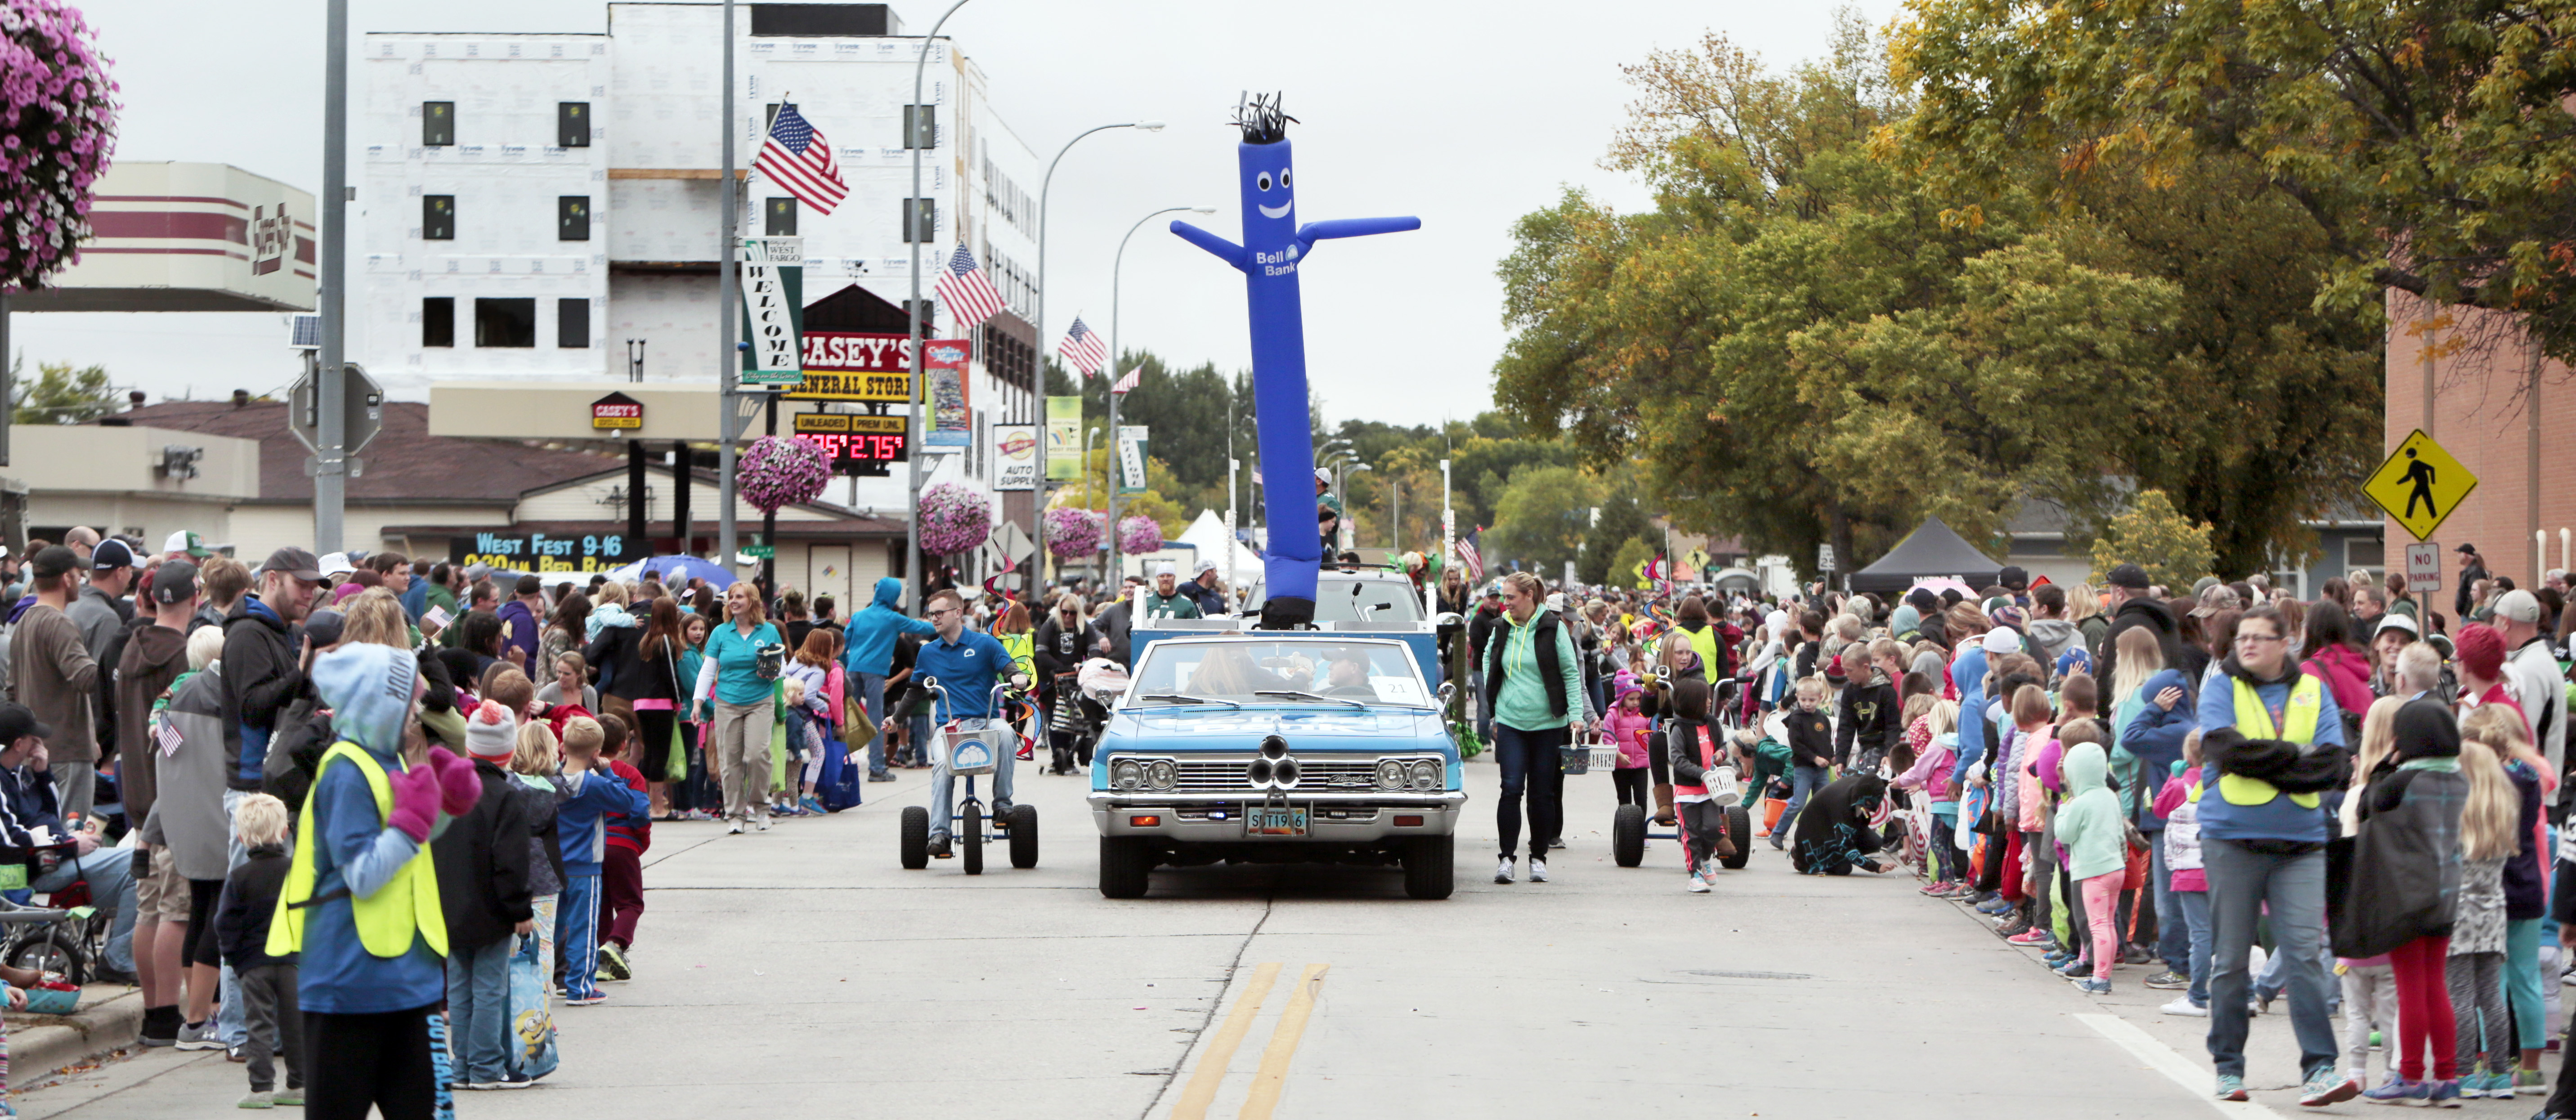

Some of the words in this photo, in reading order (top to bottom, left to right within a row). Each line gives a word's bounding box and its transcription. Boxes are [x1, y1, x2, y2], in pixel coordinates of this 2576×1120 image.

[1256, 251, 1284, 264] Bell
[1265, 262, 1295, 276] Bank
[748, 266, 789, 366] WELCOME
[746, 372, 760, 380] City
[801, 418, 847, 427] UNLEADED
[857, 419, 880, 428] PREM
[883, 420, 899, 428] UNL
[1006, 466, 1033, 474] AUTO
[582, 535, 622, 557] 9-16
[2415, 553, 2430, 565] NO
[2408, 572, 2438, 582] PARKING
[1388, 684, 1407, 693] 21
[1329, 774, 1369, 782] Chevrolet
[1252, 815, 1302, 827] ST196
